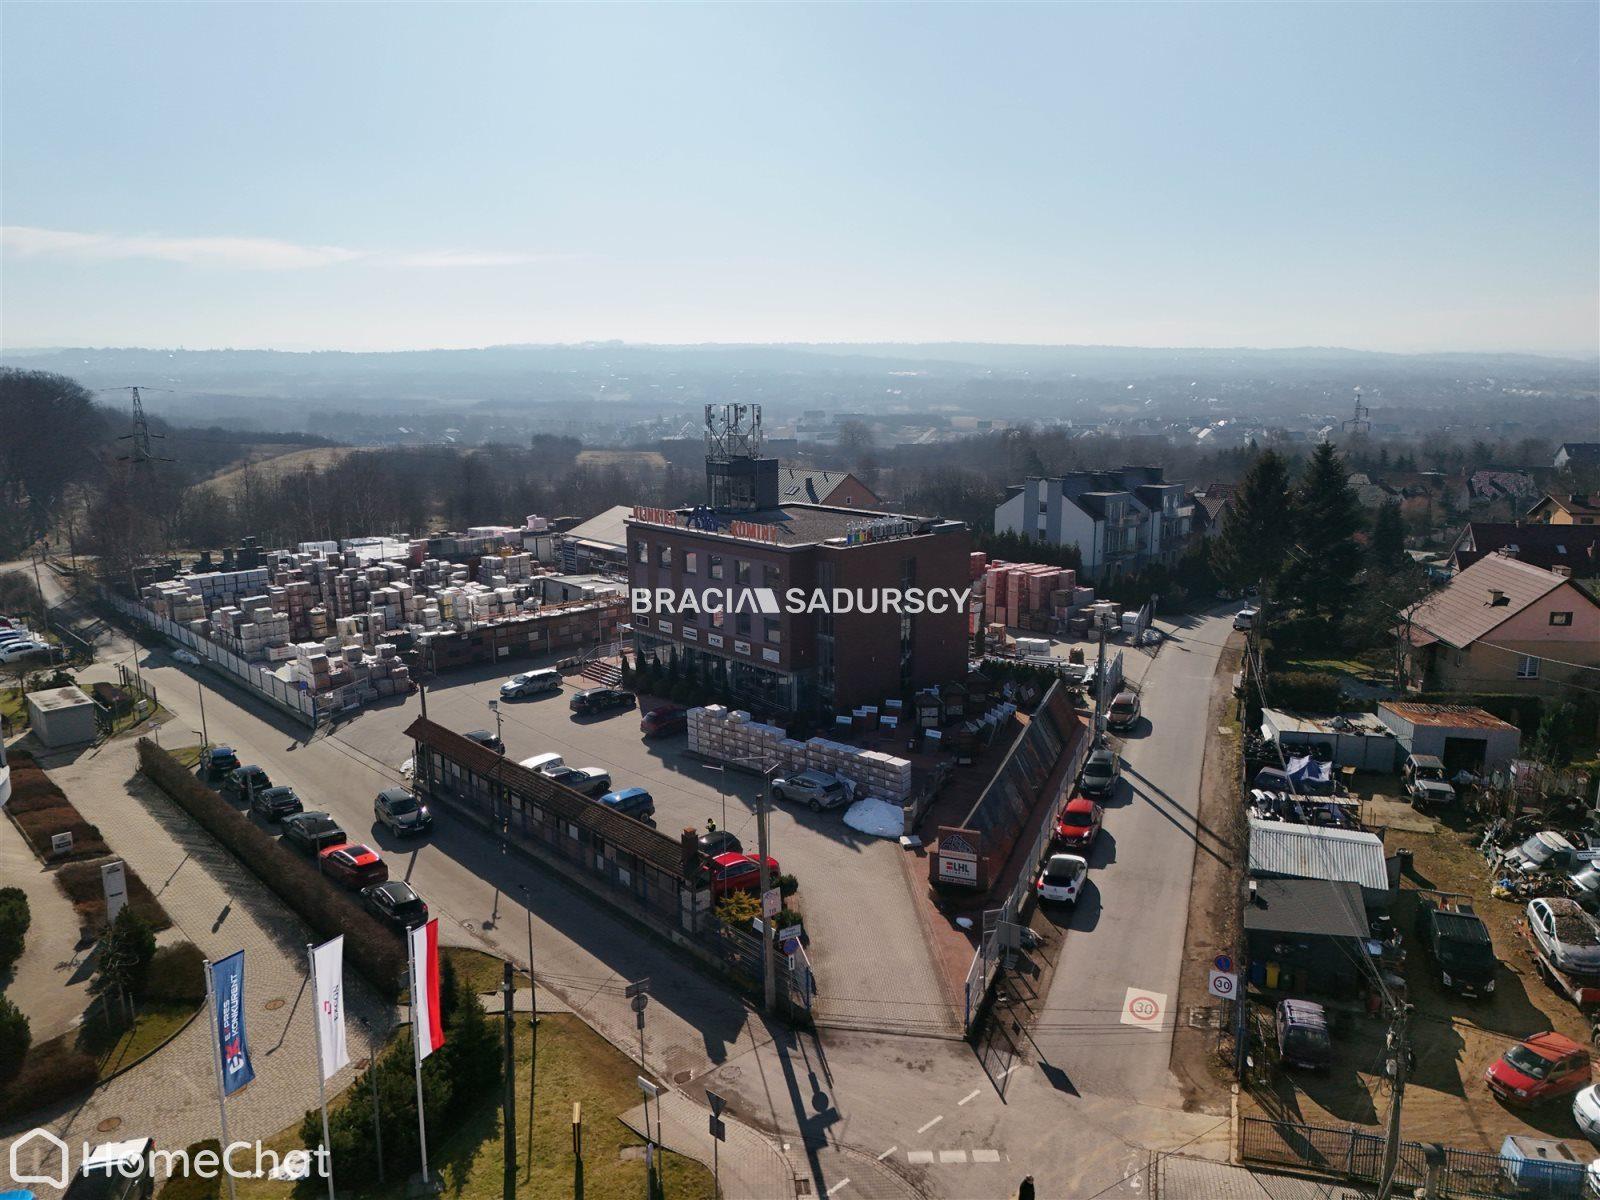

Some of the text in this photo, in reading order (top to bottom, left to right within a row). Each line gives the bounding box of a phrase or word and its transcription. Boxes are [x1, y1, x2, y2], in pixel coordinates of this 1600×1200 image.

[1216, 979, 1229, 990] 30
[230, 974, 239, 1038] KONKURENT
[1135, 1002, 1153, 1015] 30
